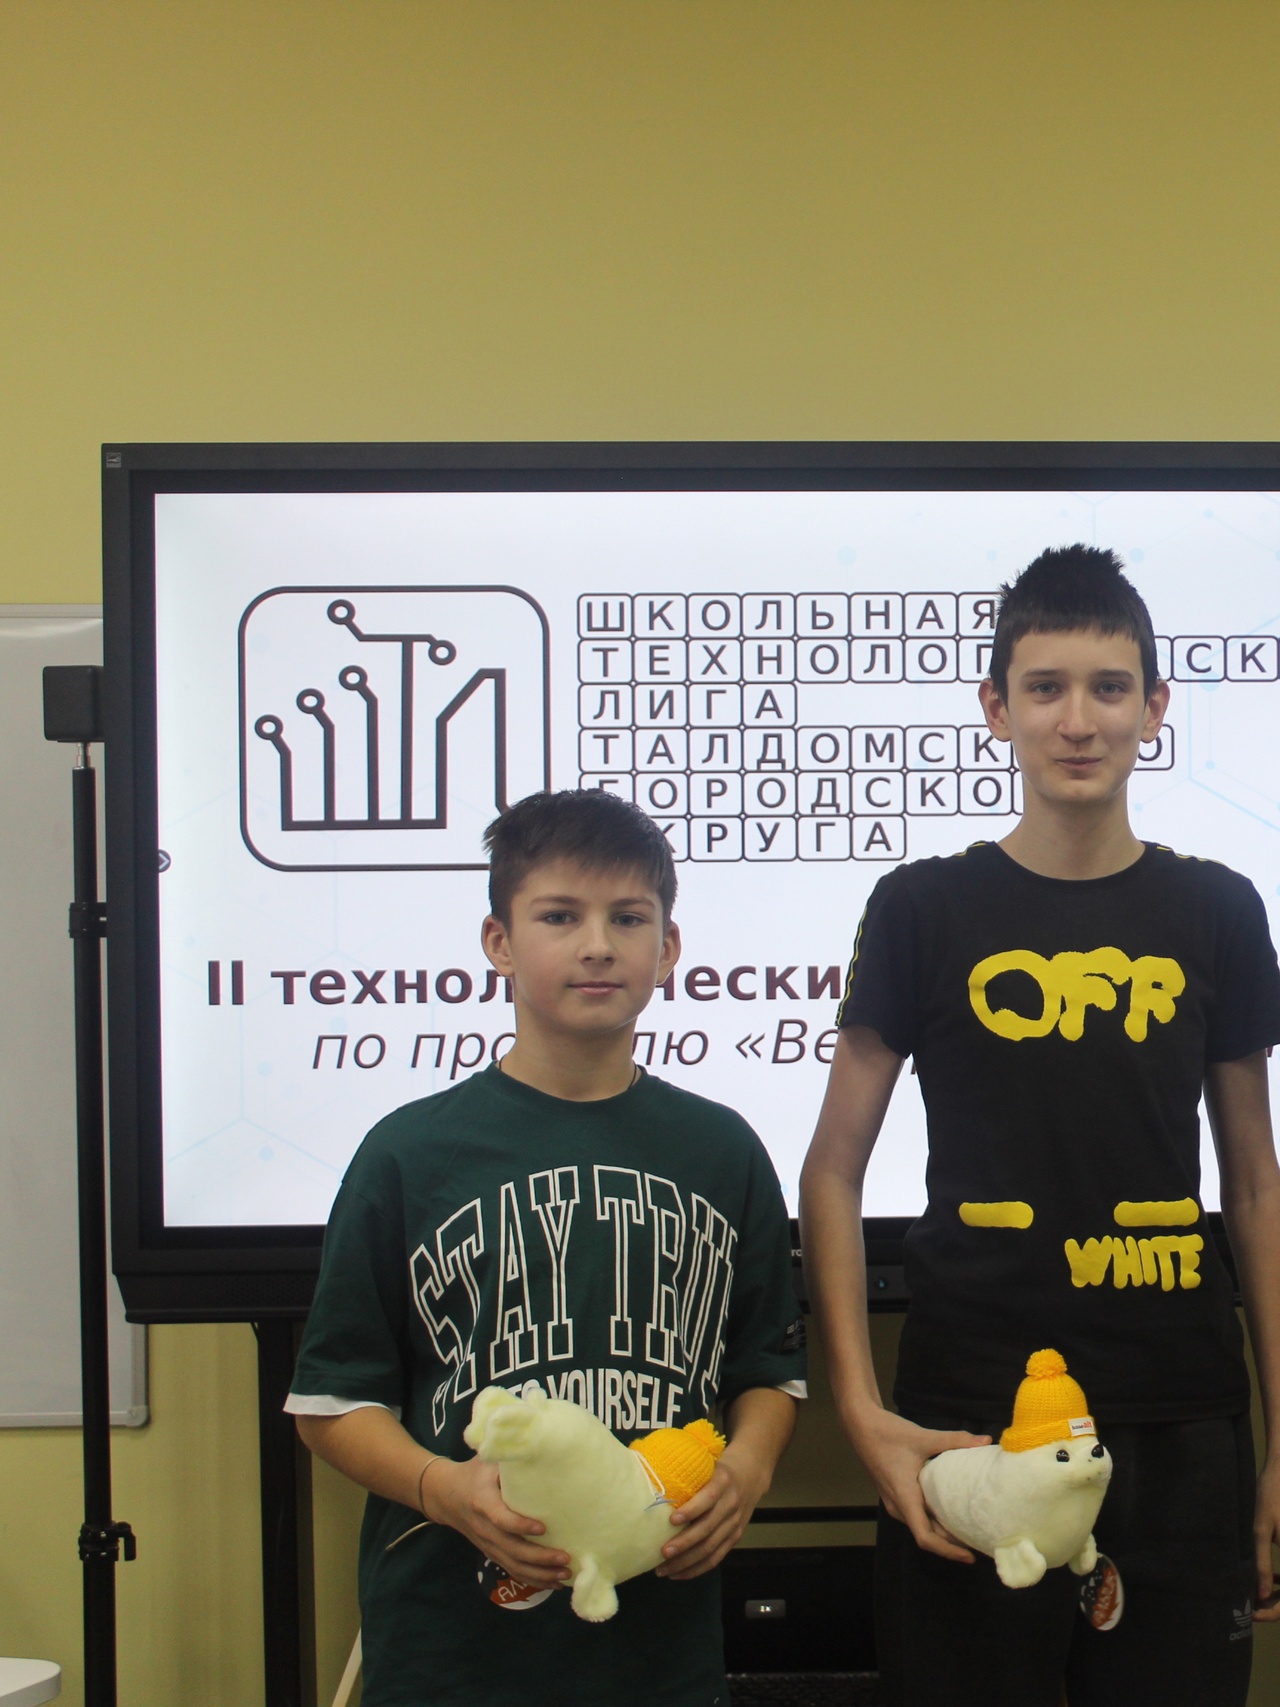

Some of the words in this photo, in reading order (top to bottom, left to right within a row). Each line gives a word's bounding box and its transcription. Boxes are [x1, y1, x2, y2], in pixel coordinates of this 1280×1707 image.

[587, 600, 995, 632] ШКОЛЬНАЯ
[593, 689, 783, 720] ЛИГА
[593, 732, 1163, 770] ТАЛДОМСКО
[599, 777, 1002, 813] ОРОДСКО
[662, 821, 892, 853] РУГА
[208, 960, 244, 1005] II
[312, 1033, 386, 1069] по
[411, 1030, 709, 1080] пролю
[1064, 1235, 1204, 1292] WHITE
[410, 1165, 581, 1436] STAY
